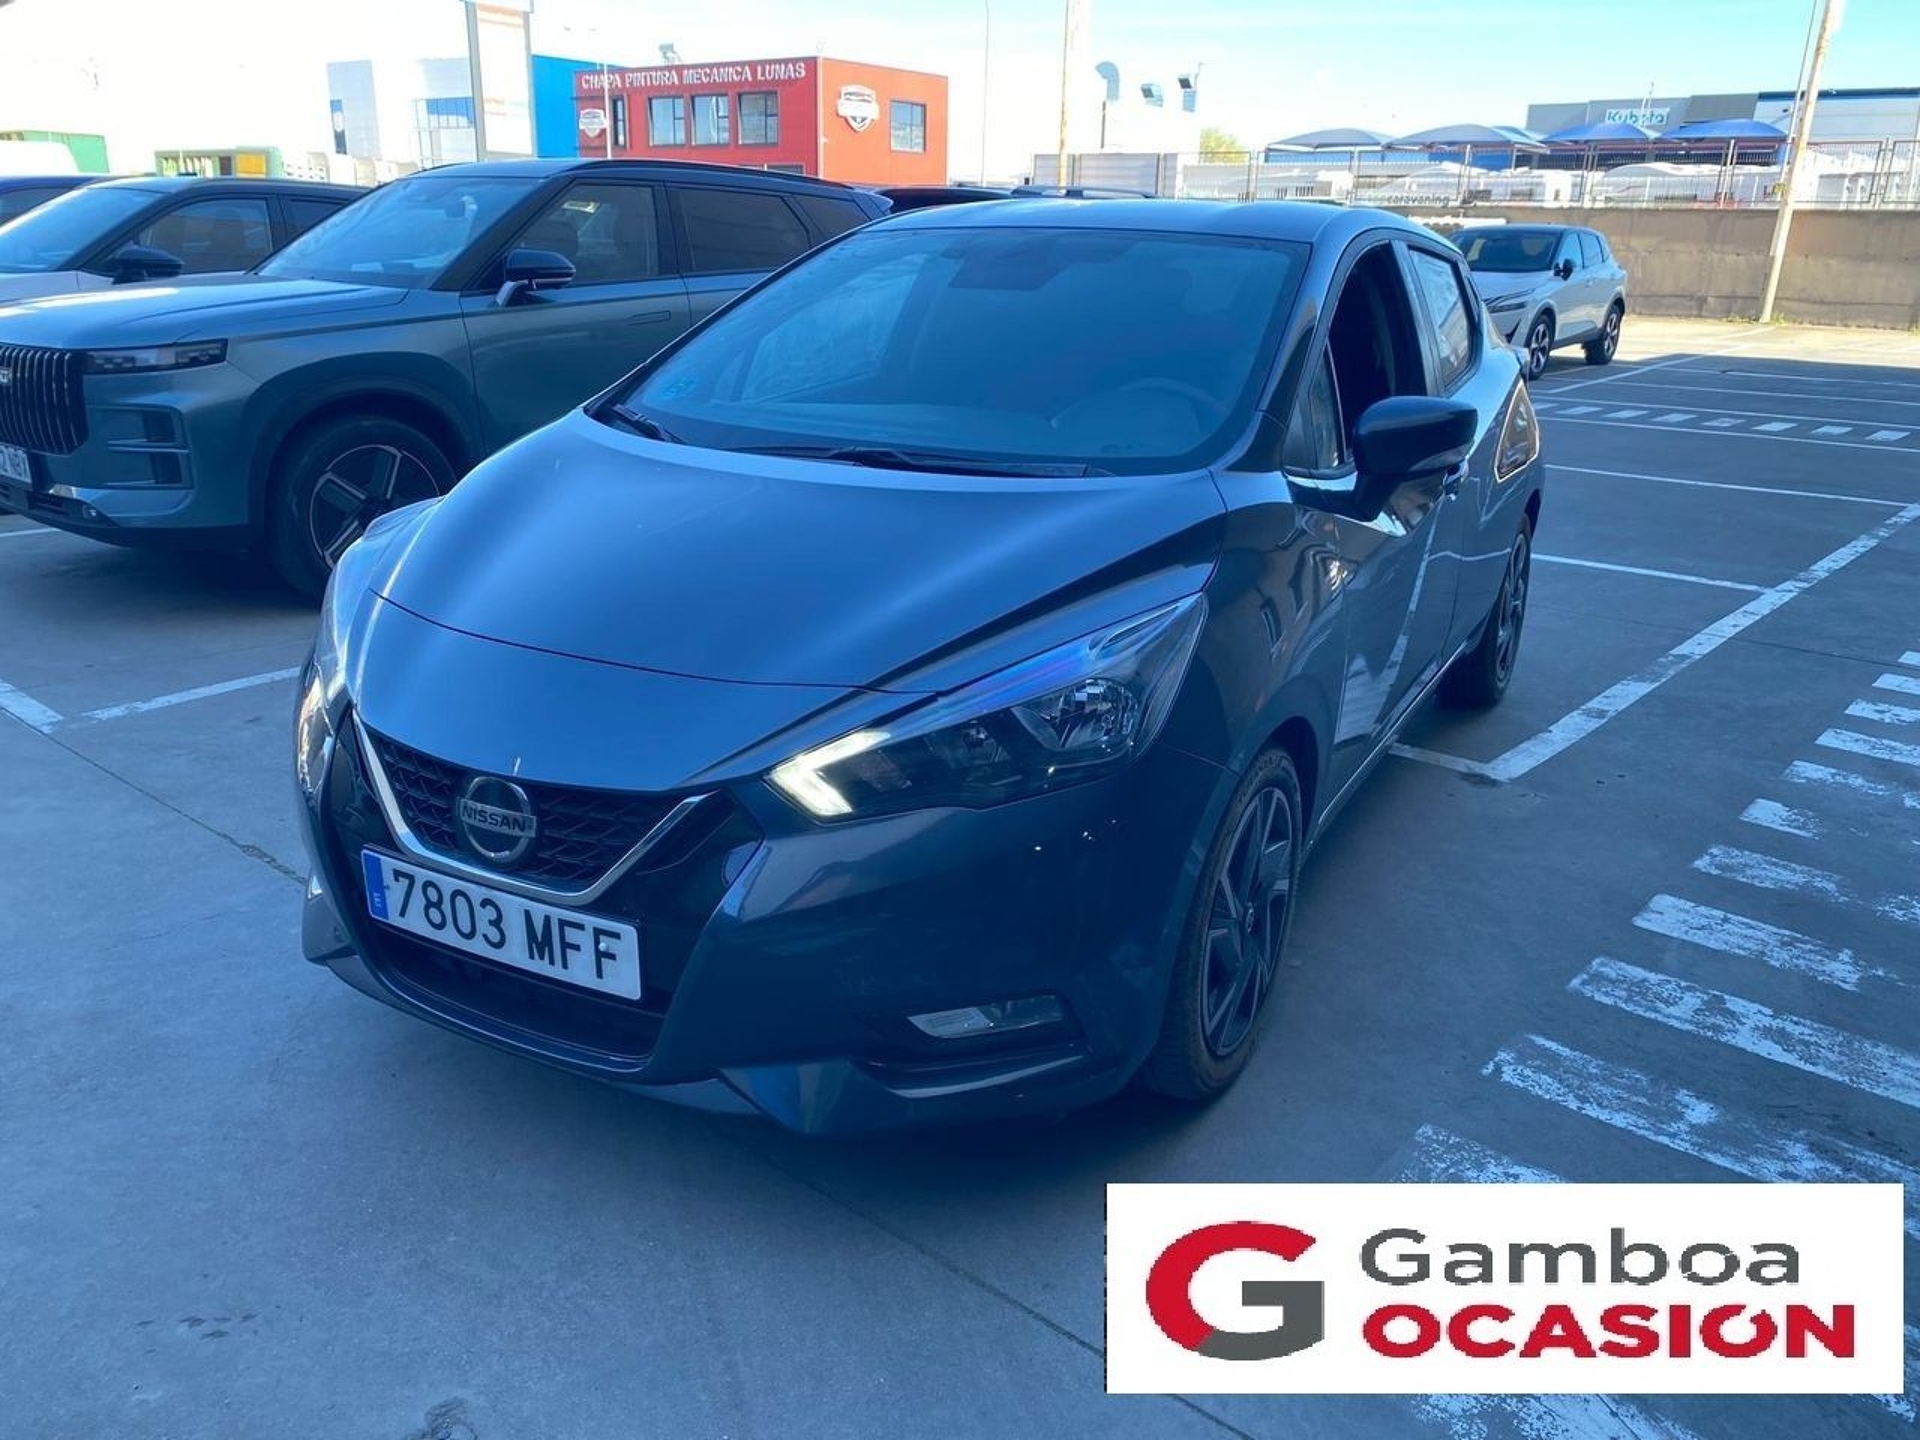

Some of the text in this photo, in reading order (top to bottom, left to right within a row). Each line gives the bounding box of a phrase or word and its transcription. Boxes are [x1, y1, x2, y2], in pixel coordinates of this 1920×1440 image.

[581, 61, 806, 91] CHAPA PINTURA MECANICA LUNAS
[461, 803, 527, 833] NISSAN
[391, 867, 622, 981] 7803 MFF
